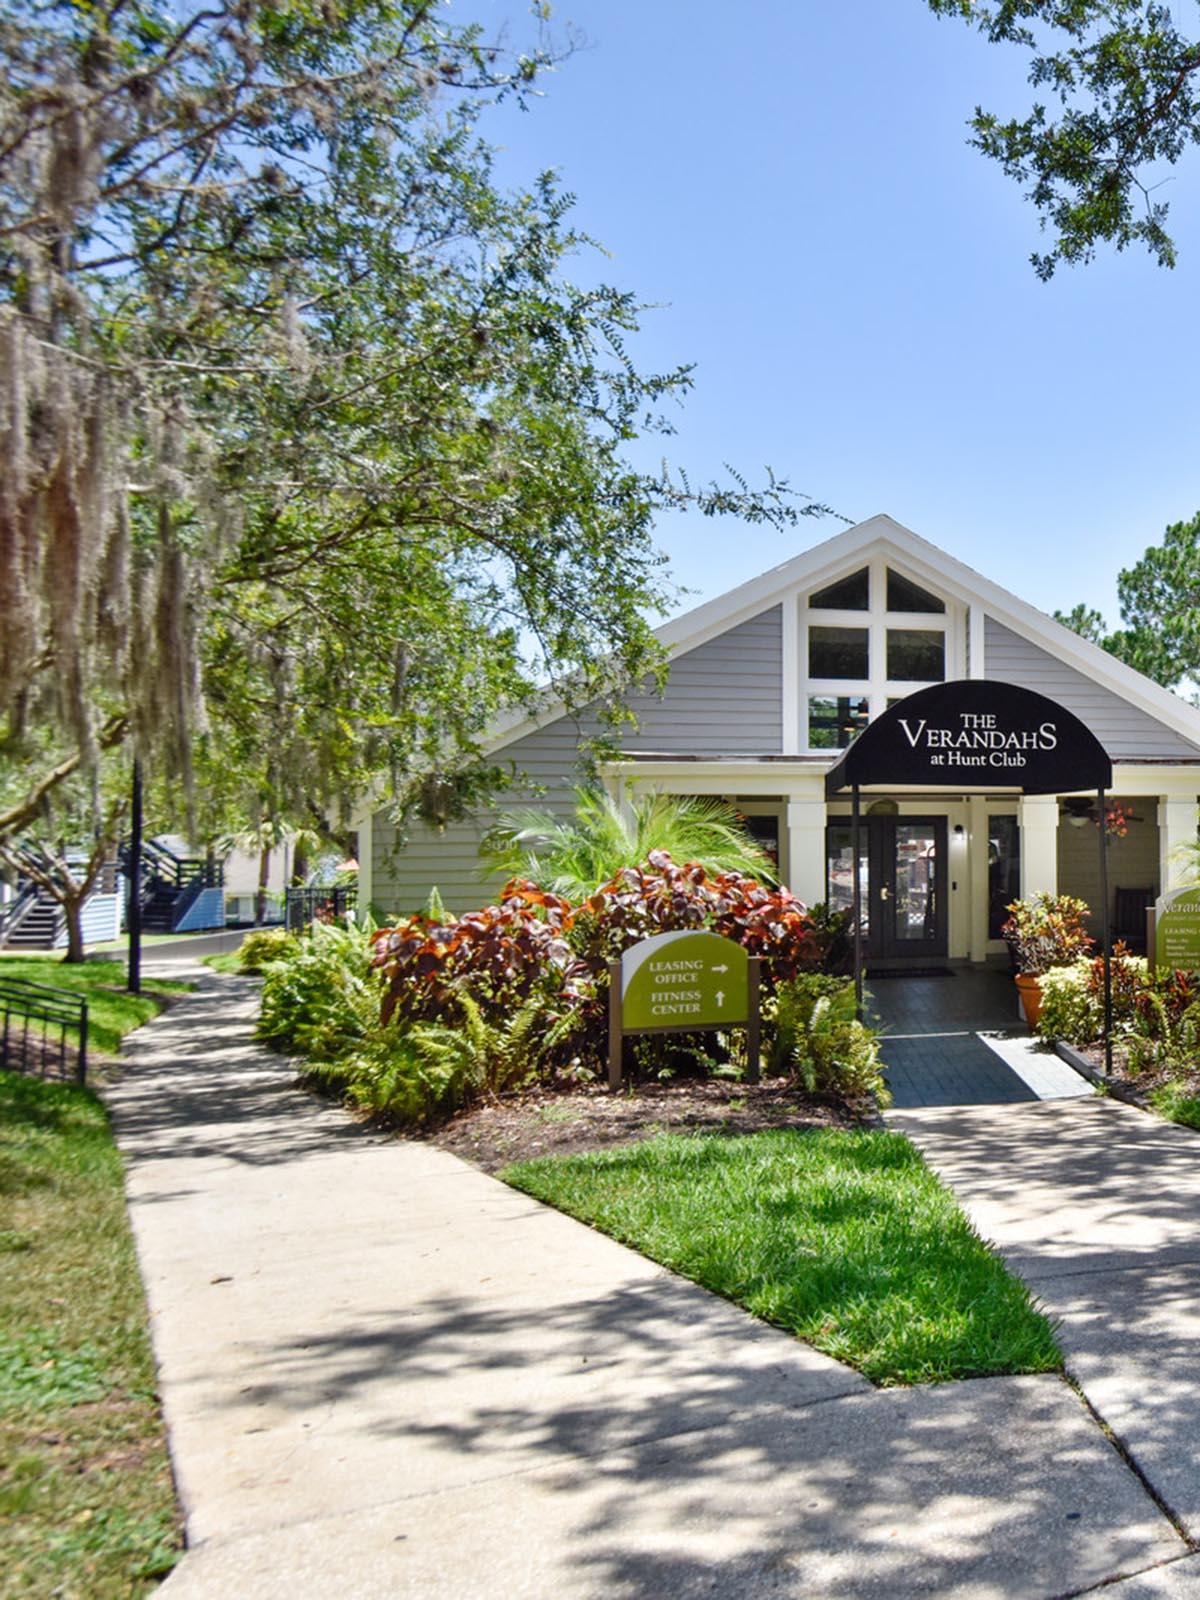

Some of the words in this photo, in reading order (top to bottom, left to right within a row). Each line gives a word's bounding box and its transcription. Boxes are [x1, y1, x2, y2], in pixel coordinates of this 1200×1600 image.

[960, 713, 997, 729] THE
[898, 719, 1058, 750] VERANDAHS
[930, 752, 945, 766] at
[948, 751, 987, 766] Hunt
[989, 751, 1027, 767] Club
[649, 960, 704, 972] LEASING
[655, 972, 698, 984] OFFICE
[651, 990, 702, 1002] FITNESS
[651, 1003, 701, 1015] CENTER
